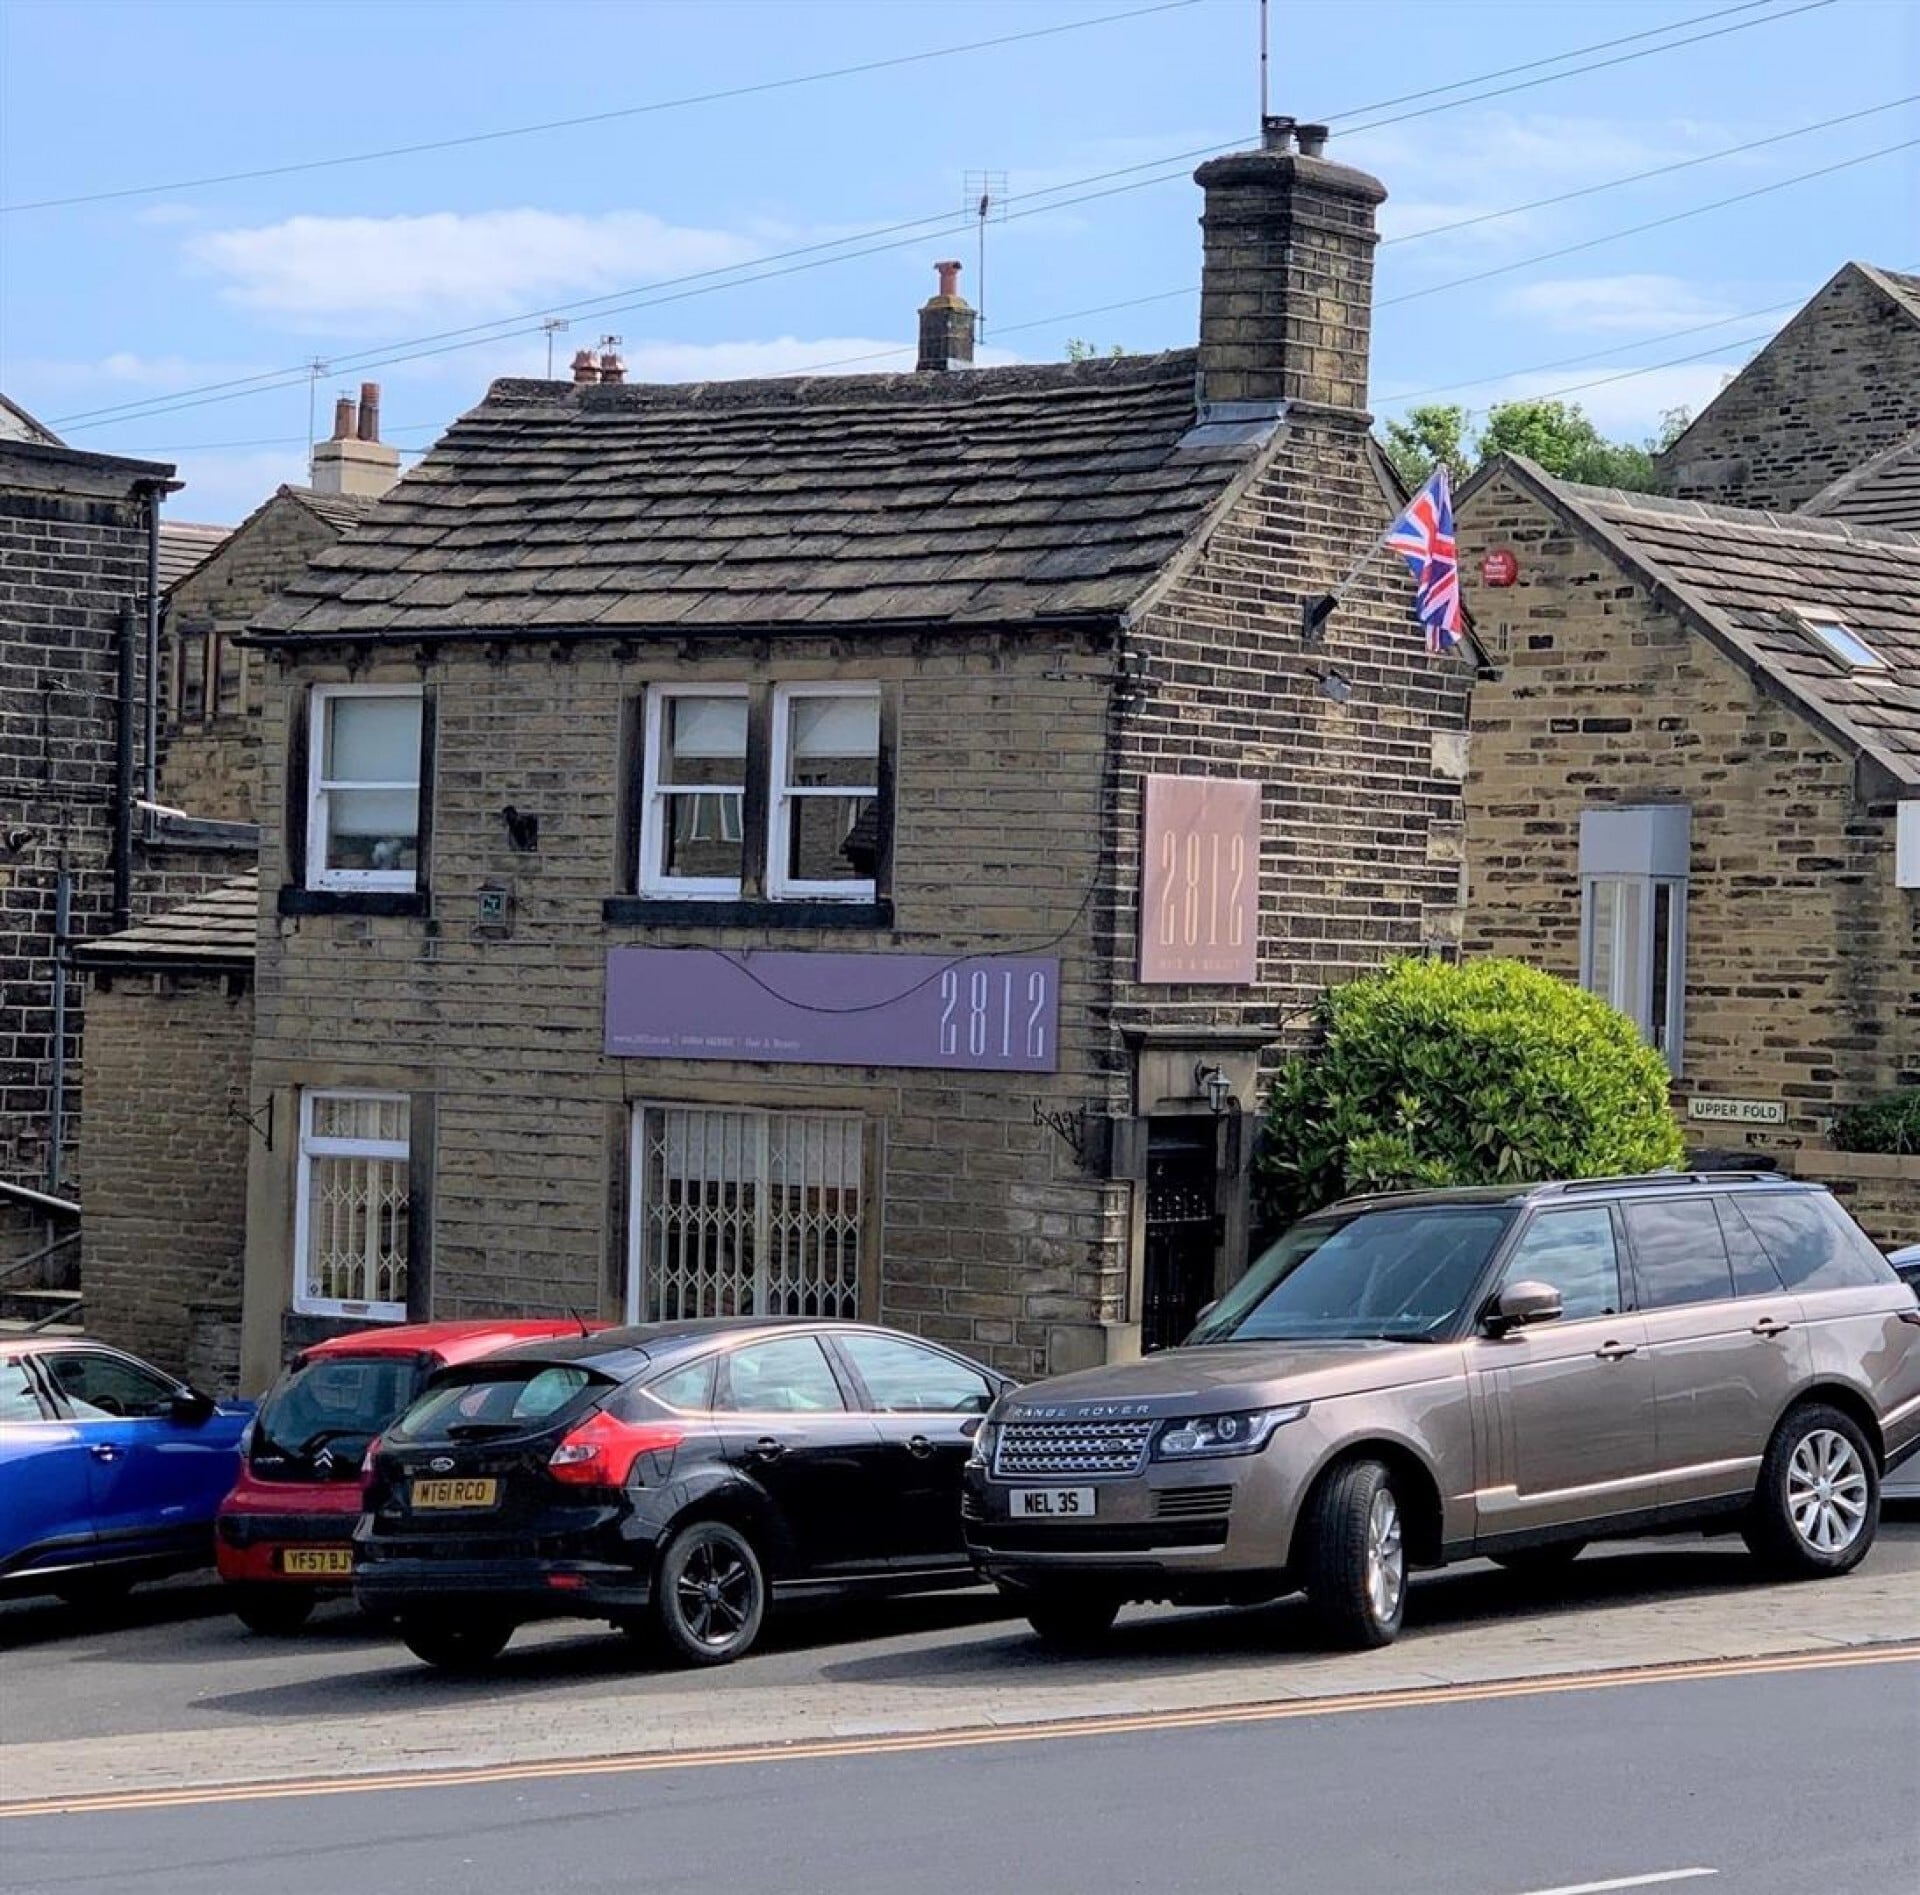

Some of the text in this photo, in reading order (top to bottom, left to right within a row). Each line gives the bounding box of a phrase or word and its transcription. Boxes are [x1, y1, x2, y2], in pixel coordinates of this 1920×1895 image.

[1160, 830, 1244, 945] 2812
[940, 970, 1044, 1058] 2812
[1695, 1102, 1777, 1118] UPPER FOLD
[1079, 1404, 1149, 1417] ROVER
[1024, 1492, 1078, 1513] NEL 3S
[287, 1552, 325, 1570] YF57
